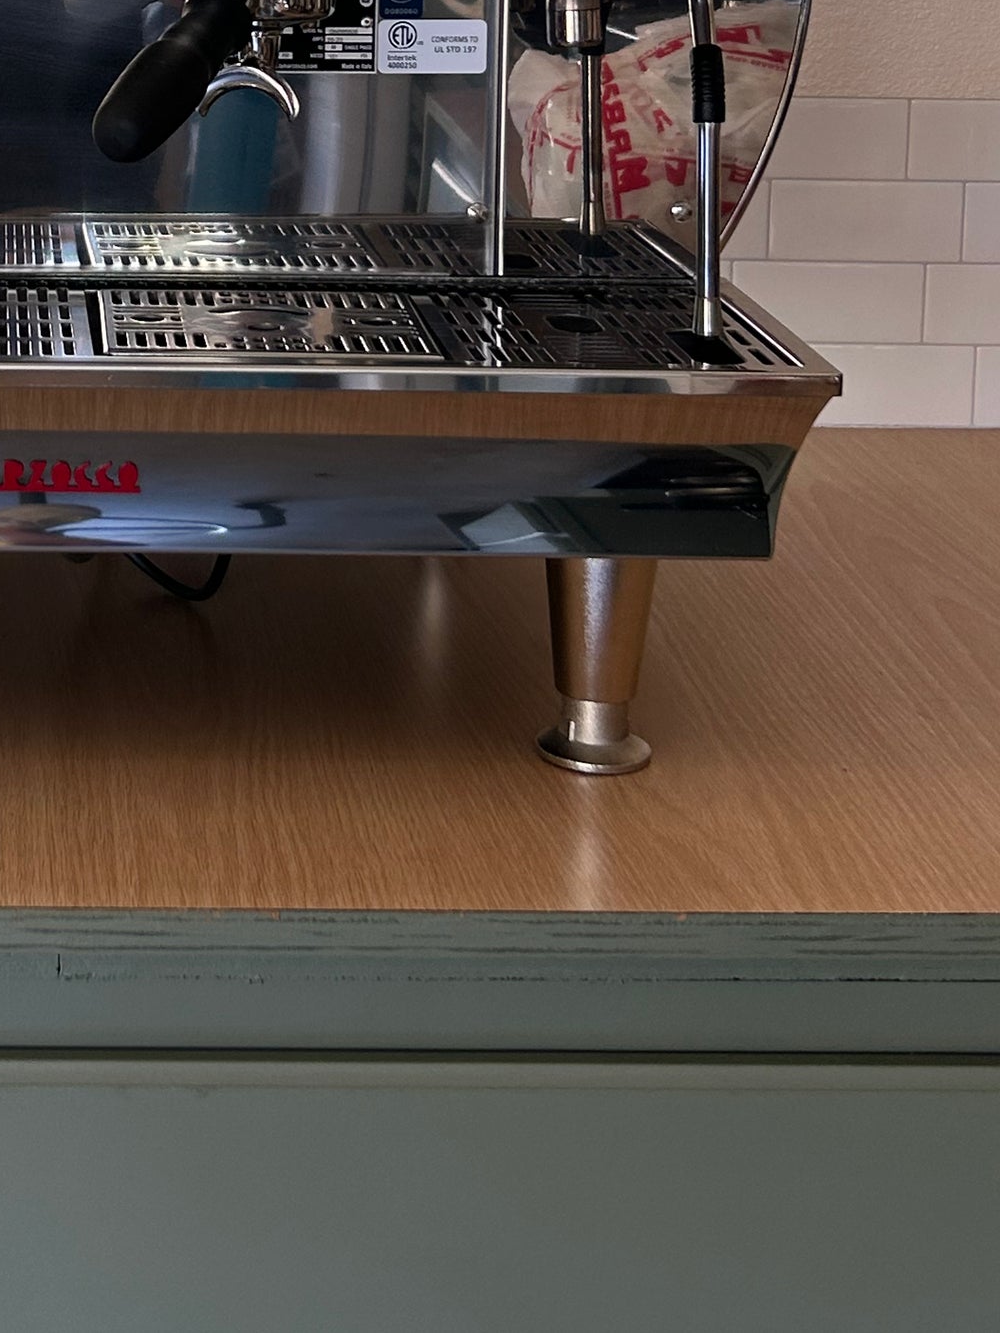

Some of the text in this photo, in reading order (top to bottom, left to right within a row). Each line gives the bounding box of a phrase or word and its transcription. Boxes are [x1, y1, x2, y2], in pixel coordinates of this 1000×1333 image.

[431, 35, 469, 43] CONFORMS
[470, 35, 479, 43] TO
[434, 45, 477, 53] UL STD 197
[387, 53, 417, 62] Intertek
